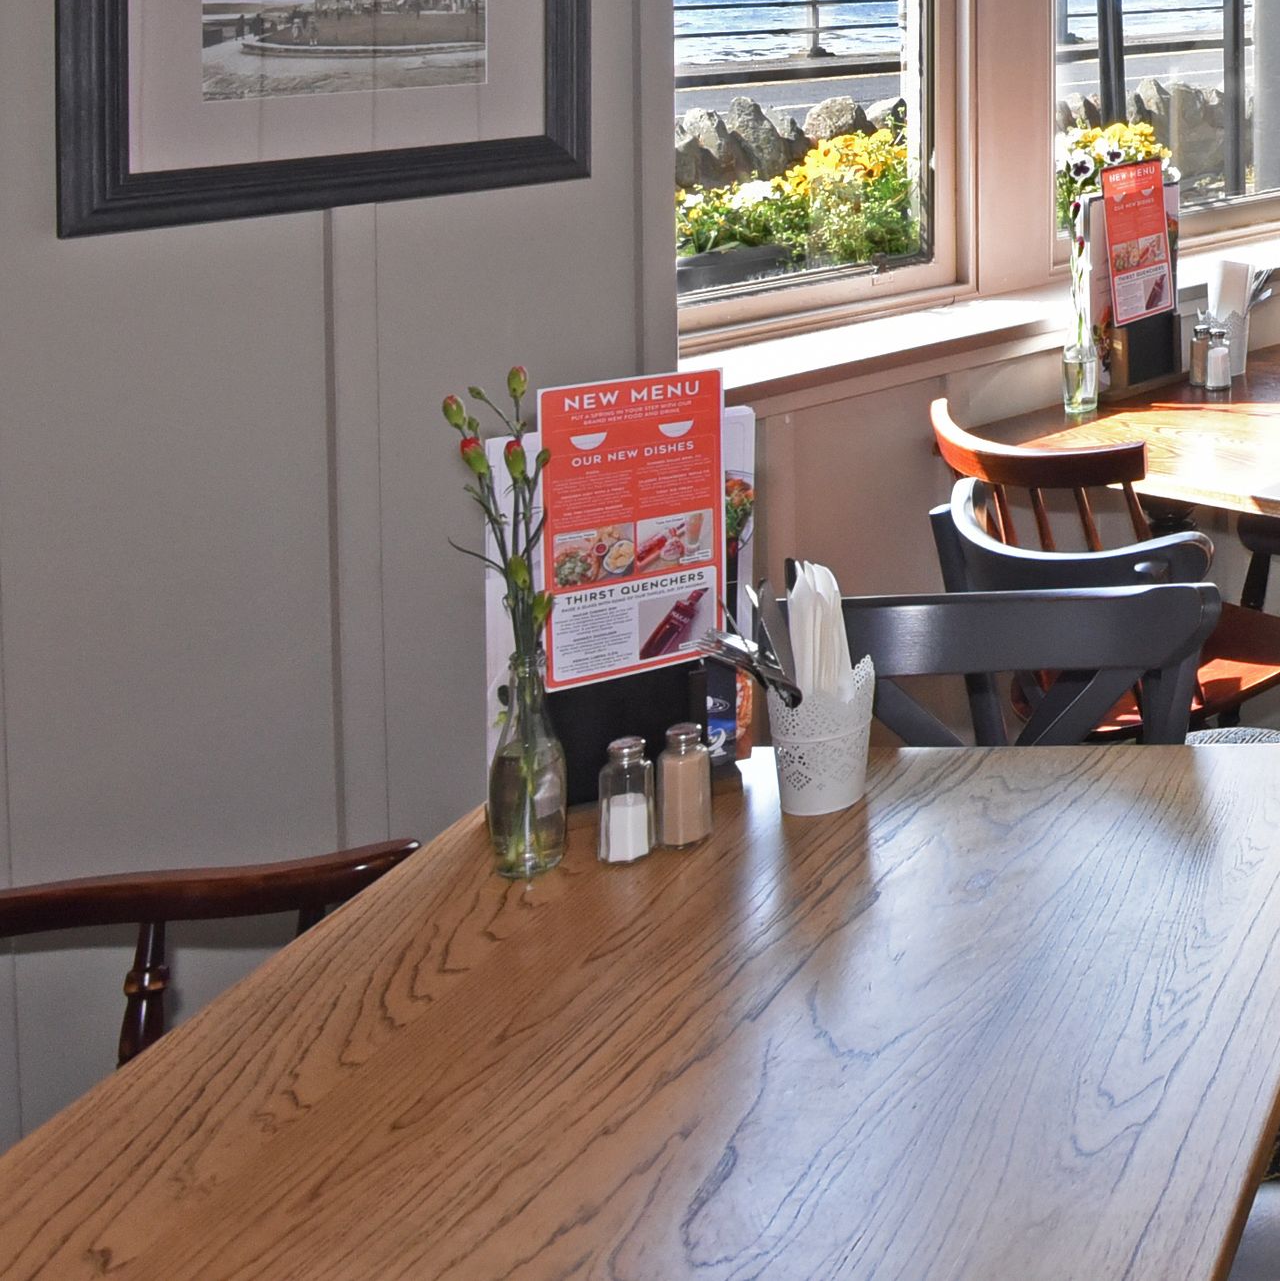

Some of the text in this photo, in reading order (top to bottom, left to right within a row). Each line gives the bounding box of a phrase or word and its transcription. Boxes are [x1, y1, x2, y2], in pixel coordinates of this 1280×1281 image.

[1109, 166, 1155, 182] NEW MENU
[564, 380, 700, 412] NEW MENU
[571, 440, 694, 468] OUR NEW DISHES
[566, 588, 615, 606] THIRST
[621, 571, 705, 595] QUENCHERS
